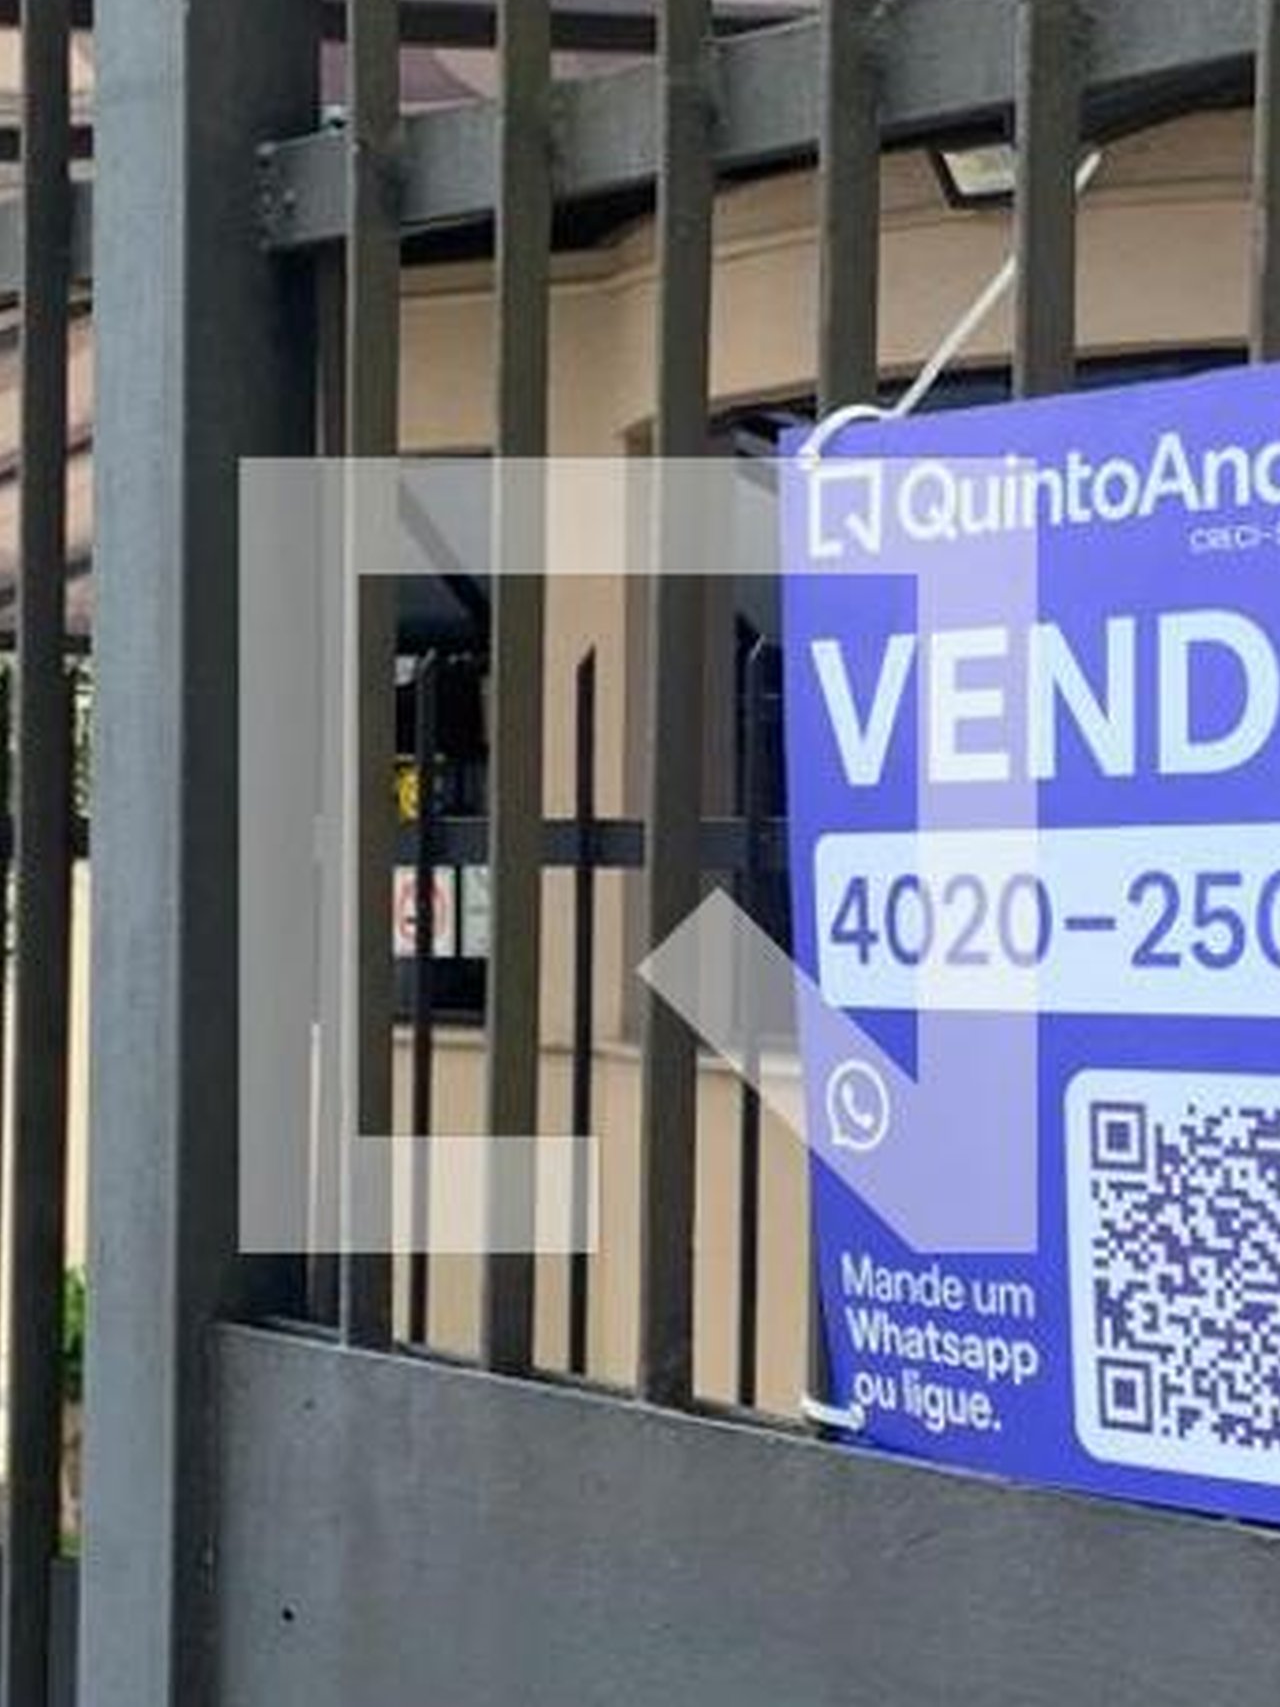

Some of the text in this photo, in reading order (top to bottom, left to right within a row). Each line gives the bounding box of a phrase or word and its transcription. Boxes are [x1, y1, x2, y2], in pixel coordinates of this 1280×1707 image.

[841, 1250, 1036, 1320] Mande um
[844, 1305, 1039, 1386] Whatsapp
[854, 1367, 1002, 1433] ou ligue.
